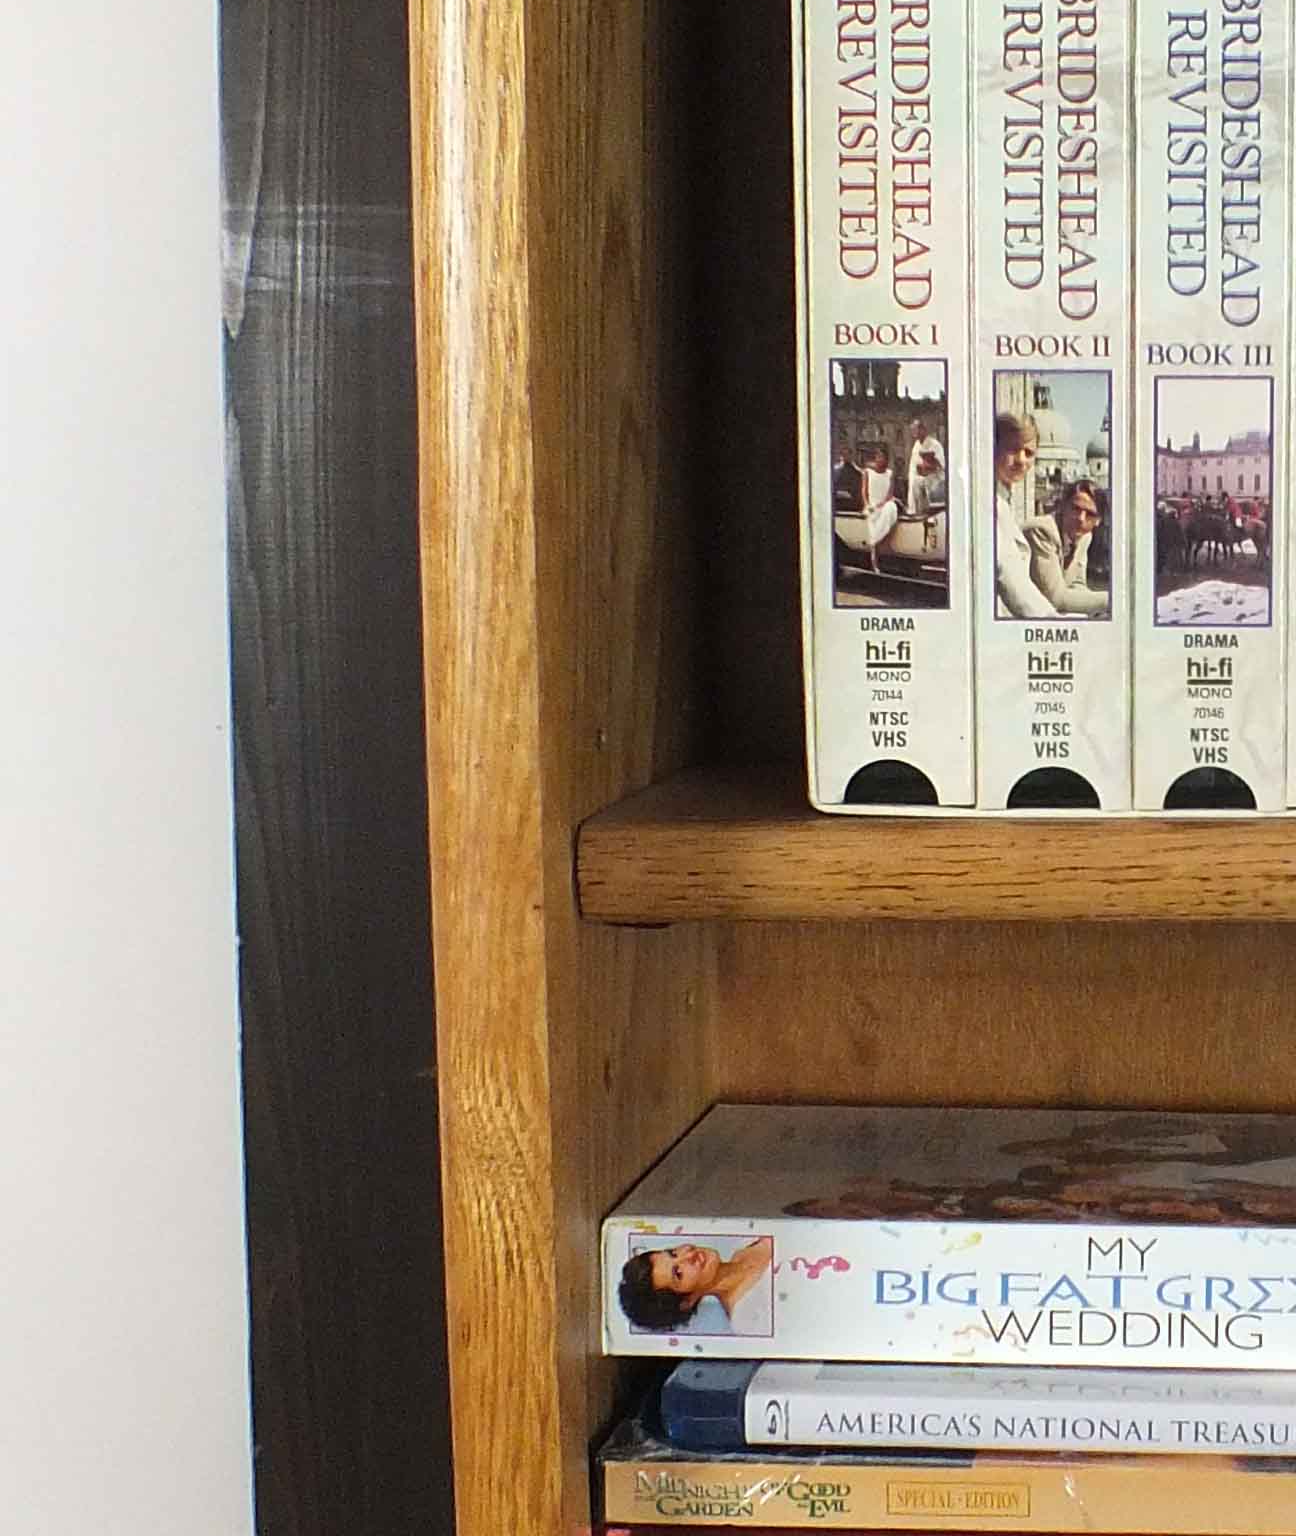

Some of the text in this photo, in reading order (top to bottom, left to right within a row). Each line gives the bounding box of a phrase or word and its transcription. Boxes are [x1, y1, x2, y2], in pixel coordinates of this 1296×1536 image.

[1003, 2, 1044, 291] REVISITED
[1167, 10, 1208, 297] REVISITED
[833, 322, 938, 346] BOOK I
[995, 335, 1110, 359] BOOK II
[1146, 343, 1272, 366] BOOK III
[860, 617, 915, 632] DRAMA
[865, 640, 911, 662] hi-fi
[866, 671, 911, 683] MONO
[871, 690, 904, 702] 70144
[1033, 702, 1066, 714] 70145
[1192, 708, 1225, 719] 70146
[869, 711, 909, 727] NTSC
[872, 731, 907, 749] VHS
[1189, 727, 1230, 743] NTSC
[1192, 747, 1229, 764] VHS
[1088, 1237, 1158, 1272] MY
[874, 1266, 978, 1305] BIG
[1000, 1270, 1149, 1309] FAT
[982, 1309, 1263, 1350] WEDDING
[817, 1410, 982, 1438] AMERICA'S
[993, 1416, 1161, 1442] NATIONAL
[634, 1470, 750, 1500] MIDNIGH
[787, 1481, 851, 1501] GOOD
[655, 1496, 754, 1517] GARDEN
[808, 1499, 851, 1518] EVIL
[896, 1491, 1021, 1511] SPECIAL EDITION
